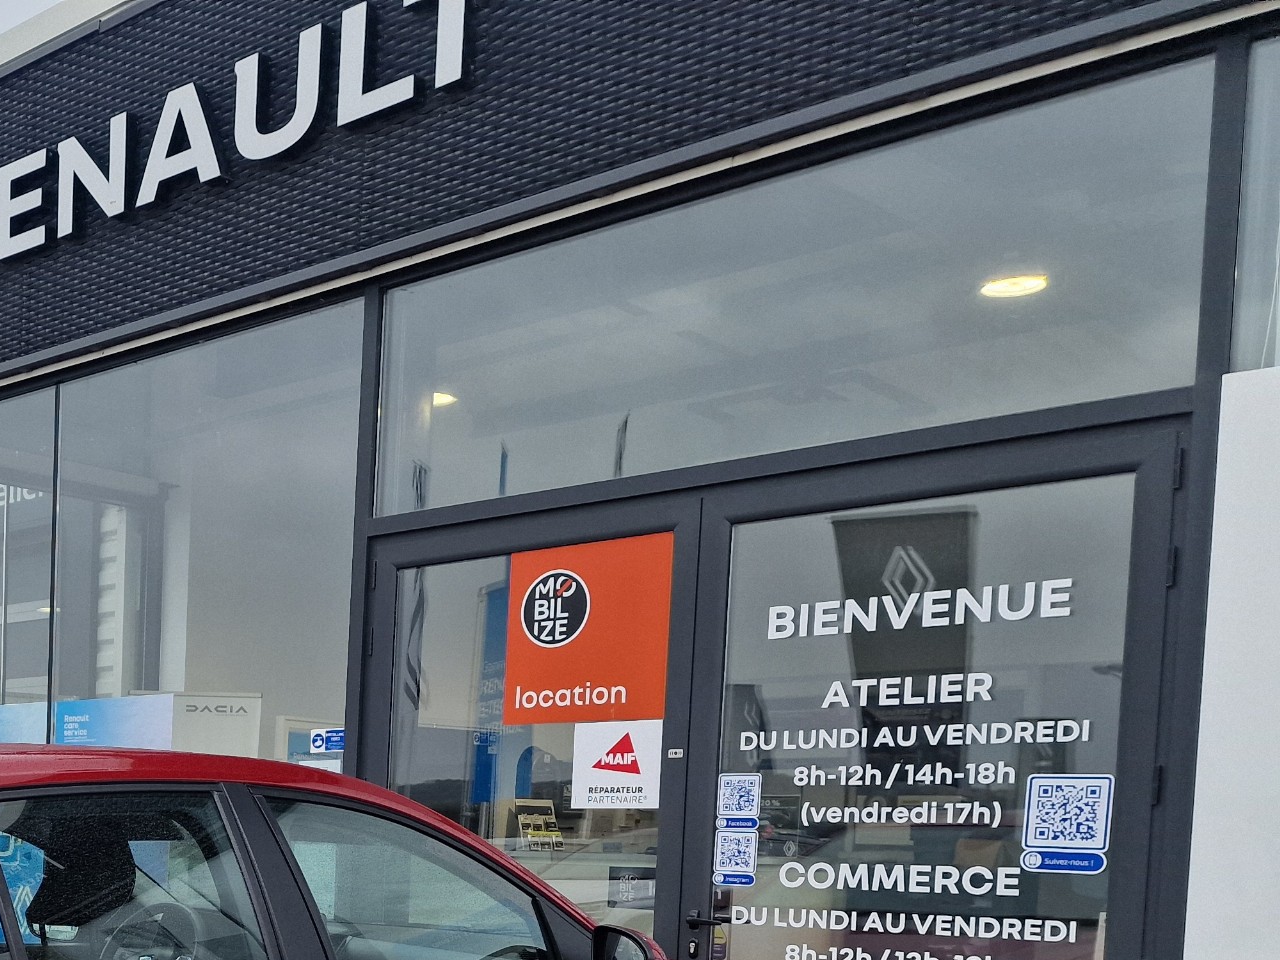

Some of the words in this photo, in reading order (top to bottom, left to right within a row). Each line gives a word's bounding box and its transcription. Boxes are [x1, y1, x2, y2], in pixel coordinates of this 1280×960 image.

[534, 597, 569, 620] BIL
[768, 578, 1073, 640] BIENVENUE
[534, 619, 568, 641] IZE
[515, 681, 627, 709] location
[821, 672, 994, 709] ATELIER
[64, 714, 90, 722] Renault
[185, 704, 249, 714] DACIA
[64, 728, 88, 736] service
[740, 730, 778, 751] DU
[783, 728, 868, 750] LUNDI
[873, 725, 918, 748] AU
[923, 719, 1091, 747] VENDREDI
[601, 752, 636, 766] MAIF
[793, 764, 883, 788] 8h-12h
[906, 761, 1016, 785] 14h-18h
[588, 785, 644, 794] RÉPARATEUR
[800, 801, 937, 828] (vendredi
[943, 801, 1003, 828] 17h)
[779, 861, 1020, 897] COMMERCE
[731, 905, 768, 926] DU
[774, 907, 858, 932] LUNDI
[863, 911, 907, 935] AU
[912, 913, 1078, 944] VENDREDI
